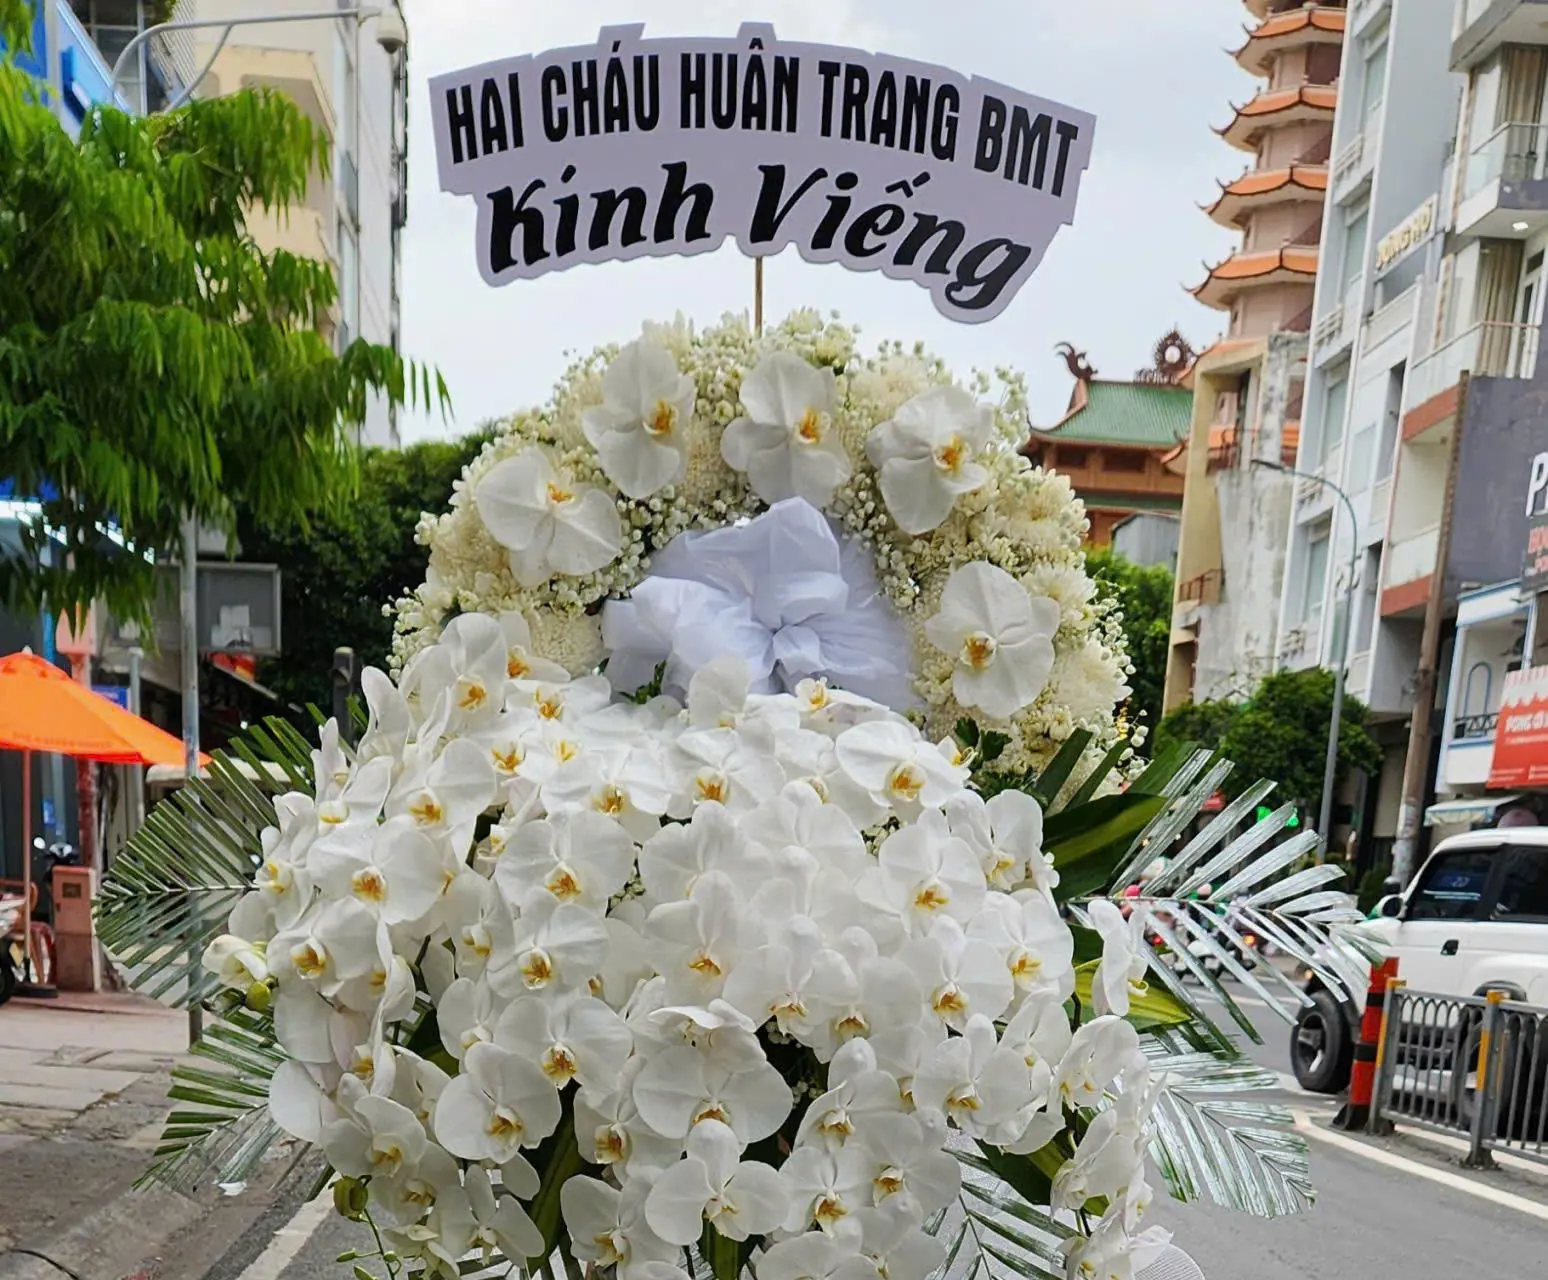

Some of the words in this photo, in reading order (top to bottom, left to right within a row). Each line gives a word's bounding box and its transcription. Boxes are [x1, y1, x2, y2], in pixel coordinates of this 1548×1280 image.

[445, 71, 525, 165] HAI
[540, 40, 660, 143] CHÁU
[679, 37, 800, 134] HUÂN
[817, 60, 960, 163] TRANG
[973, 94, 1079, 198] BMT
[486, 160, 714, 275] Kính
[749, 164, 1032, 310] Viếng
